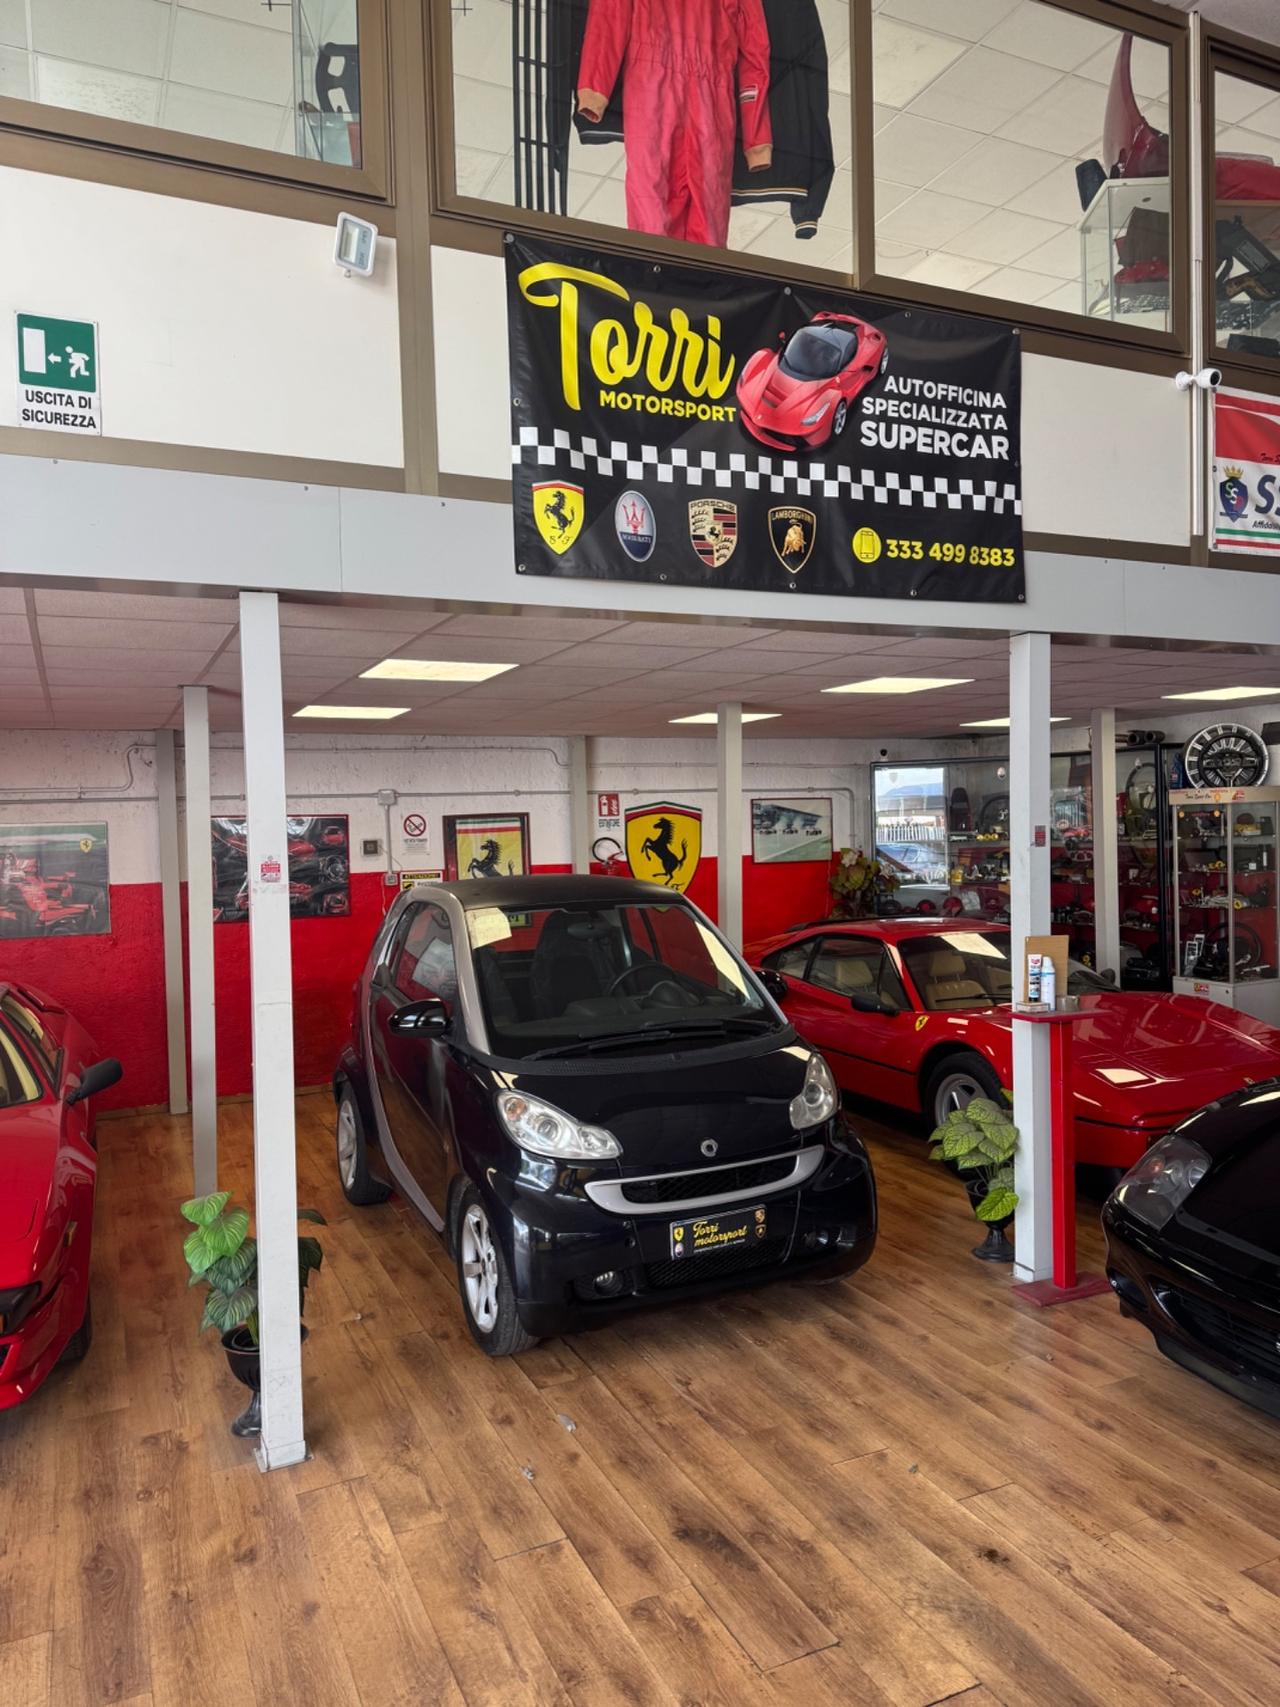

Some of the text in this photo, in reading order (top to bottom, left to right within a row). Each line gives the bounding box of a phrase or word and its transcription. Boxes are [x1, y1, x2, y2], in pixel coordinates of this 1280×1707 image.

[518, 262, 736, 411] Torri
[25, 389, 92, 409] USCITA DI
[884, 375, 1007, 409] AUTOFFICINA
[22, 408, 96, 428] SICUREZZA
[600, 390, 737, 422] MOTORSPORT
[862, 397, 1008, 431] SPECIALIZZATA
[860, 420, 1009, 460] SUPERCAR
[690, 500, 736, 512] PORSCHE
[771, 510, 813, 524] LAMBORGHINI
[886, 539, 1015, 567] 333 499 8383
[693, 1221, 719, 1238] Torri
[694, 1225, 748, 1247] motorsport
